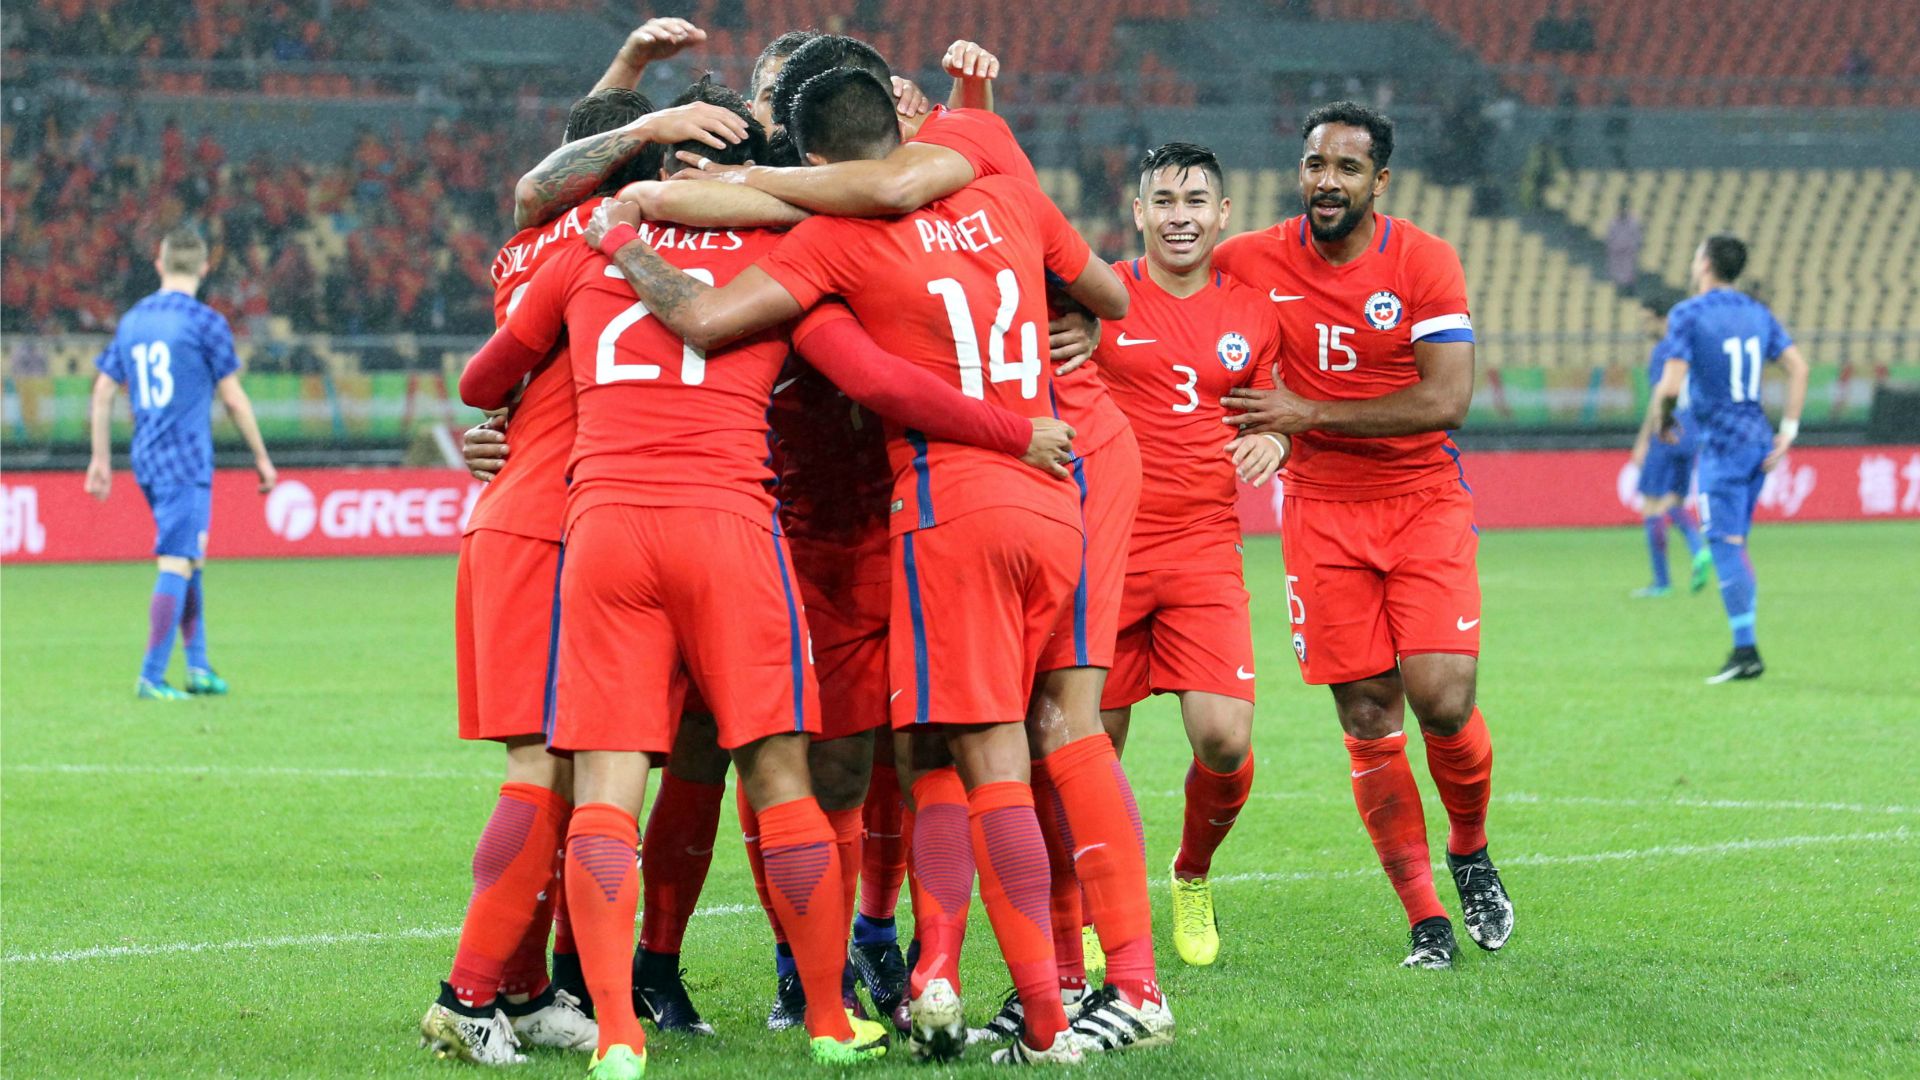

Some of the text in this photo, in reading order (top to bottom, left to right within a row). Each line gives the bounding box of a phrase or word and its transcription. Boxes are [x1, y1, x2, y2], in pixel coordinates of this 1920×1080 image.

[926, 268, 1042, 401] 14
[1315, 323, 1357, 371] 15
[131, 340, 174, 410] 13
[1171, 364, 1199, 413] 3
[1723, 336, 1761, 402] 11
[320, 488, 459, 538] GREE
